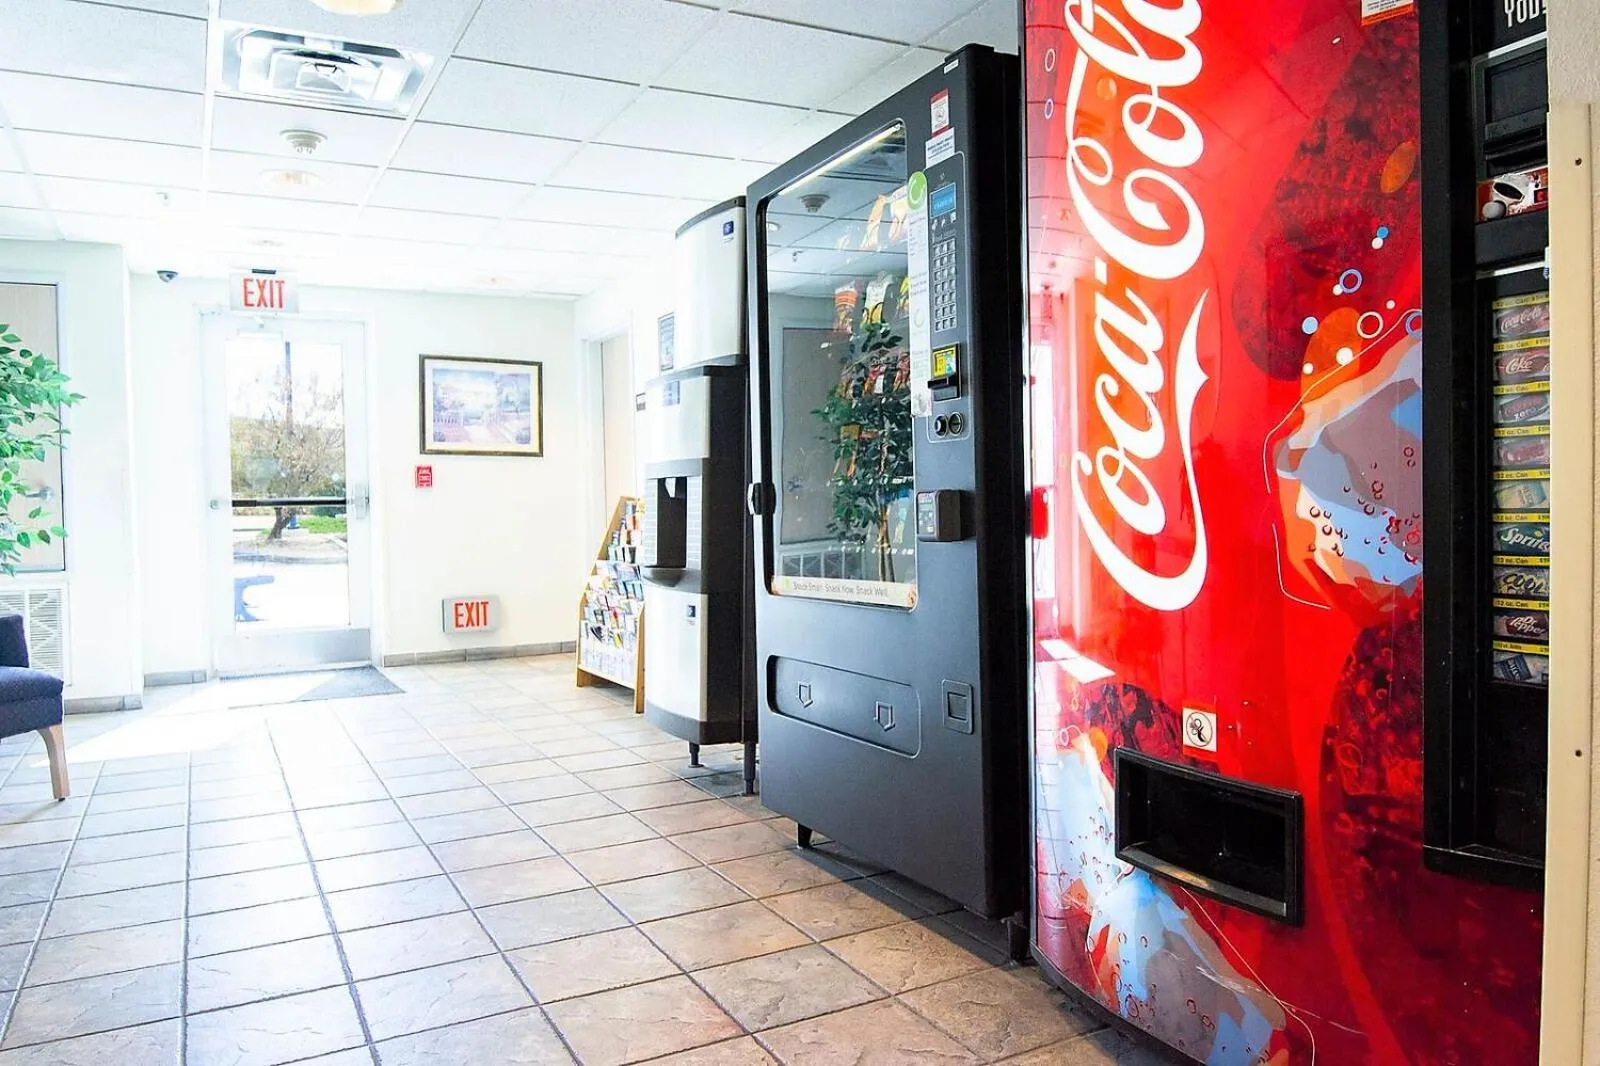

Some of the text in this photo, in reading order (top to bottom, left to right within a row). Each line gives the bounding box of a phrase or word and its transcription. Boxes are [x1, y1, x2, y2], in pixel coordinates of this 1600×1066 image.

[243, 278, 285, 308] EXIT
[1506, 357, 1534, 374] Coke
[1500, 528, 1549, 552] Sprite
[455, 601, 489, 628] EXIT
[1522, 616, 1536, 628] Dr
[1510, 617, 1546, 633] Pepper
